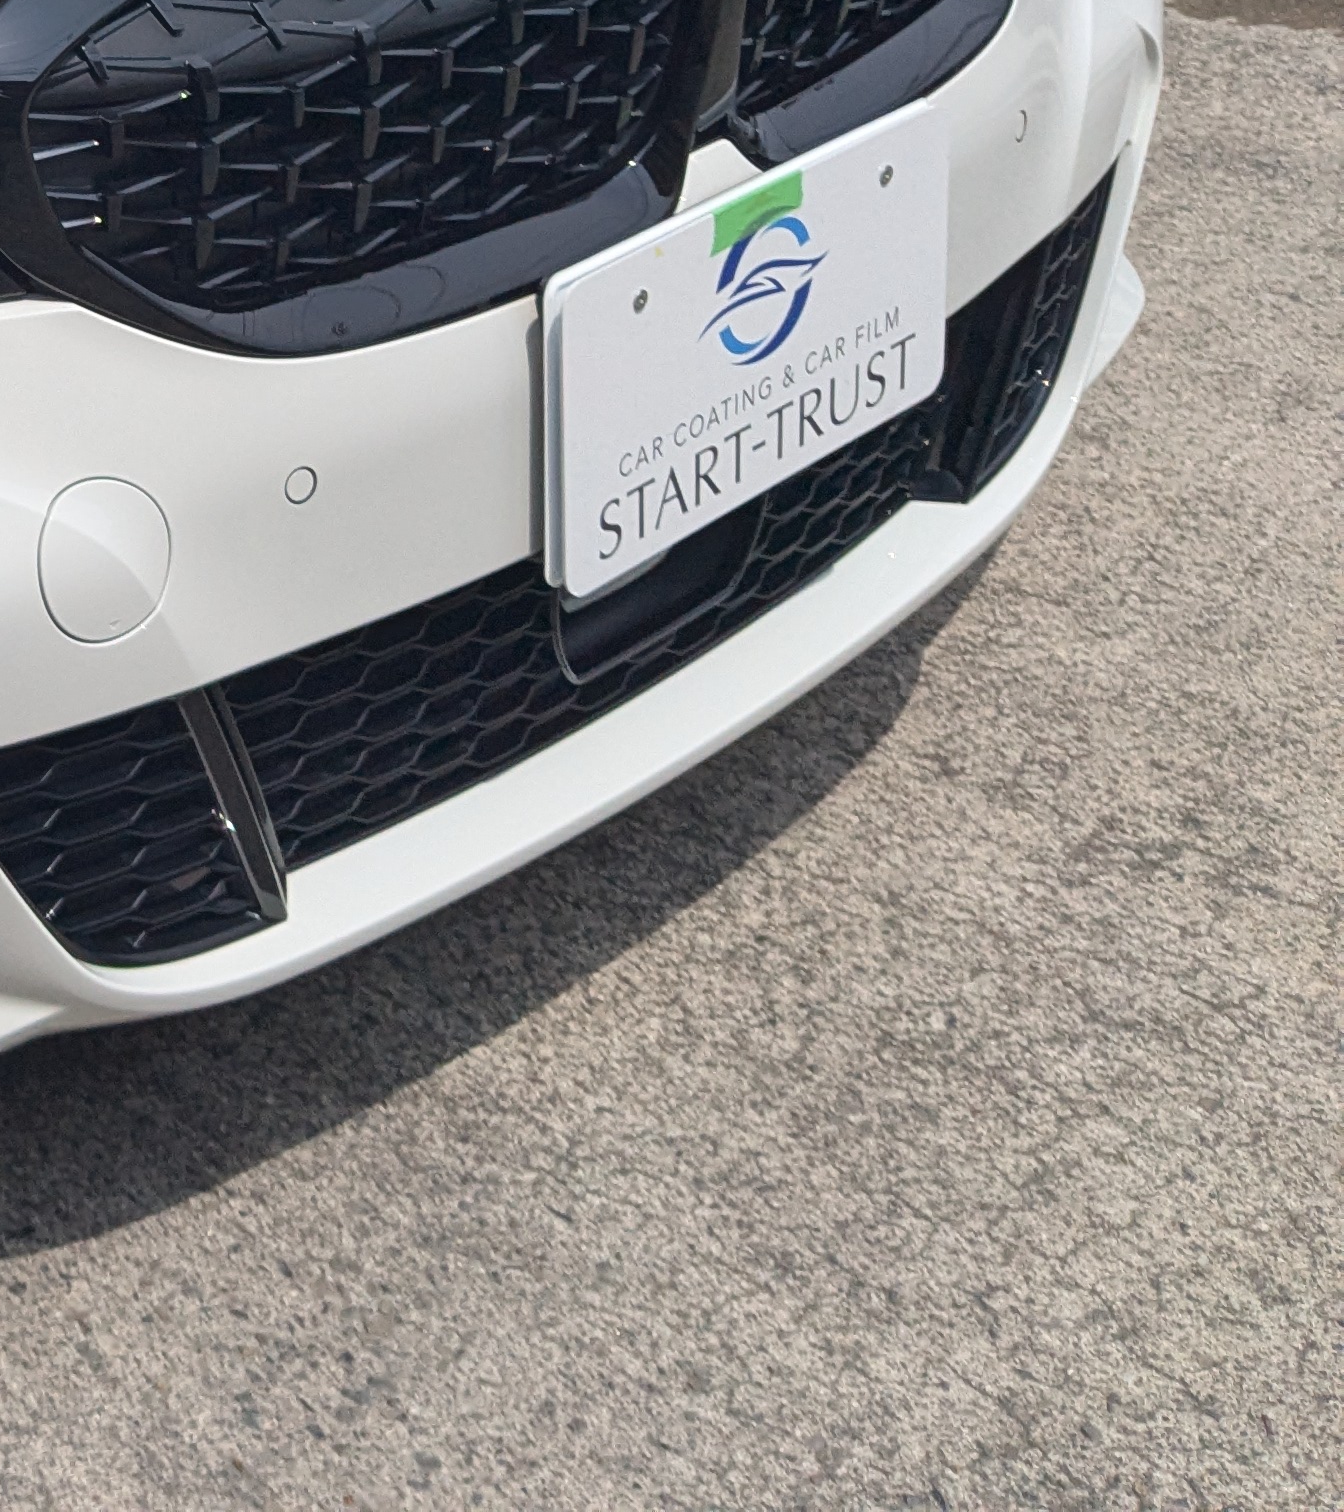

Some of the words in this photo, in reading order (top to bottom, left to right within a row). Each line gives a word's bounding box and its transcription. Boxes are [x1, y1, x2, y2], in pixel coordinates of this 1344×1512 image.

[598, 333, 917, 561] START-TRUST
[618, 442, 665, 478] CAR
[673, 376, 773, 448] COATING
[782, 364, 796, 388] &
[804, 338, 847, 376] CAR
[855, 306, 901, 348] FILM
